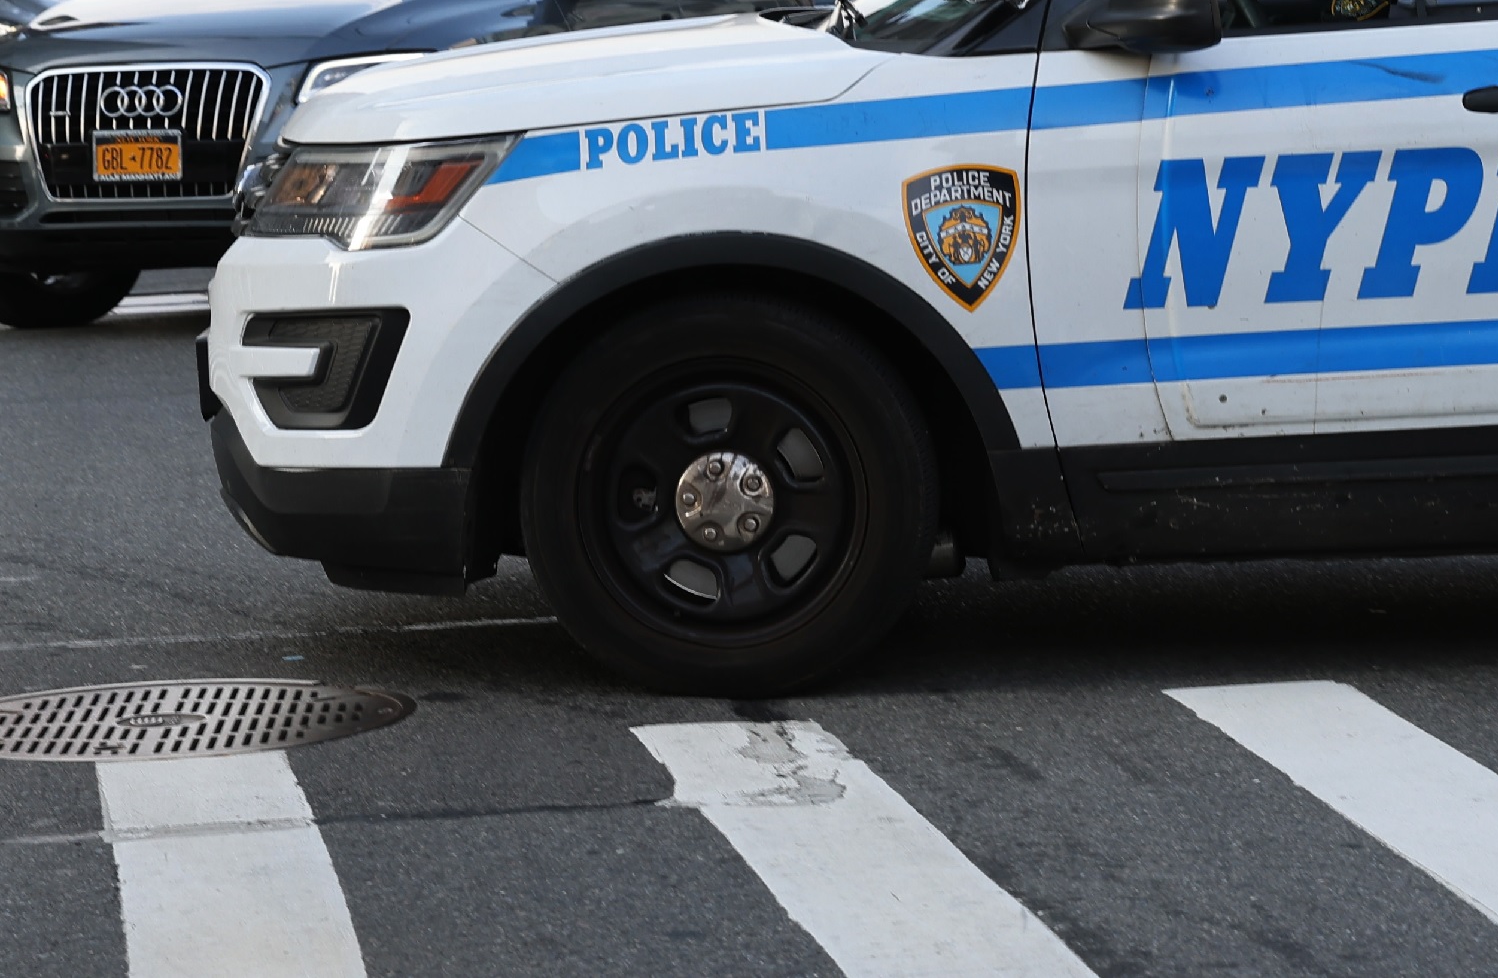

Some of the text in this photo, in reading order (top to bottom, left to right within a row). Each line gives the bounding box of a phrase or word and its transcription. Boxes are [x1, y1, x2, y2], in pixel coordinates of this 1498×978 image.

[102, 146, 173, 171] GBL 7782
[584, 110, 761, 170] POLICE
[911, 184, 1012, 217] DEPARTMENT
[930, 170, 990, 190] POLICE
[915, 231, 957, 285] CITY OF
[977, 214, 1014, 290] NEW YORK
